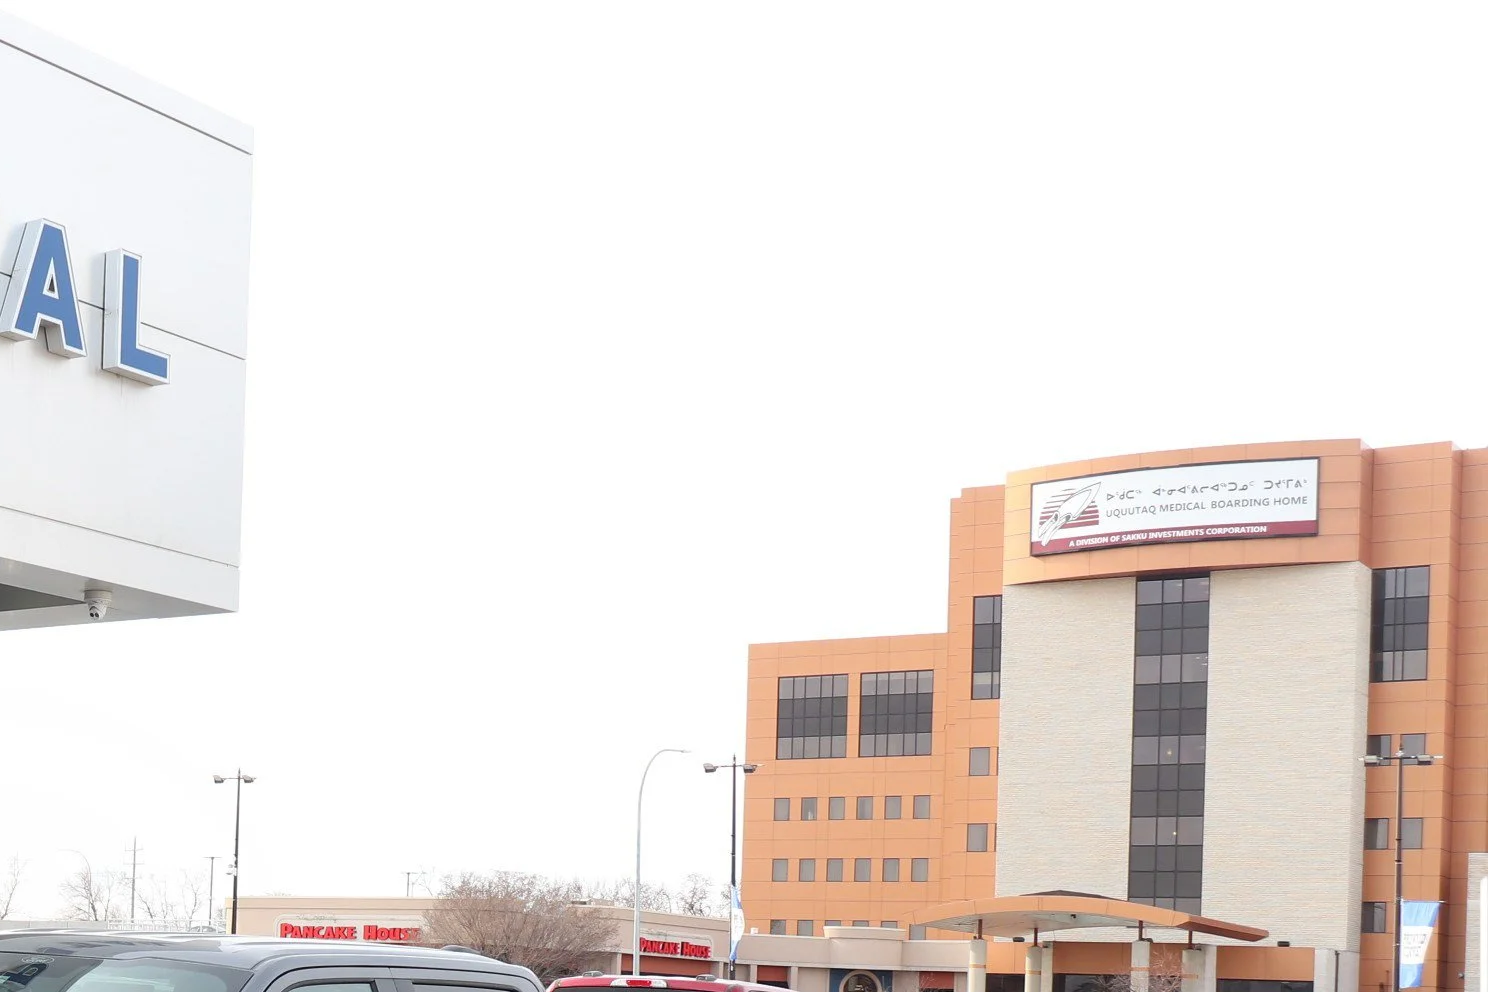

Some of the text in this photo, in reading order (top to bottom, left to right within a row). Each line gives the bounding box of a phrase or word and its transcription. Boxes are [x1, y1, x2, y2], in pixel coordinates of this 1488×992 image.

[1105, 495, 1308, 518] UQUUTAQ MEDICAL BOARDING HOME
[1076, 536, 1109, 547] DIVISION
[1110, 535, 1120, 543] OF
[1121, 532, 1147, 542] SAKKU
[1148, 528, 1204, 540] INVESTMENTS
[1205, 525, 1267, 536] CORPORATION
[280, 923, 357, 940] PANCAKE
[639, 937, 711, 959] PANCAKE HOUSE
